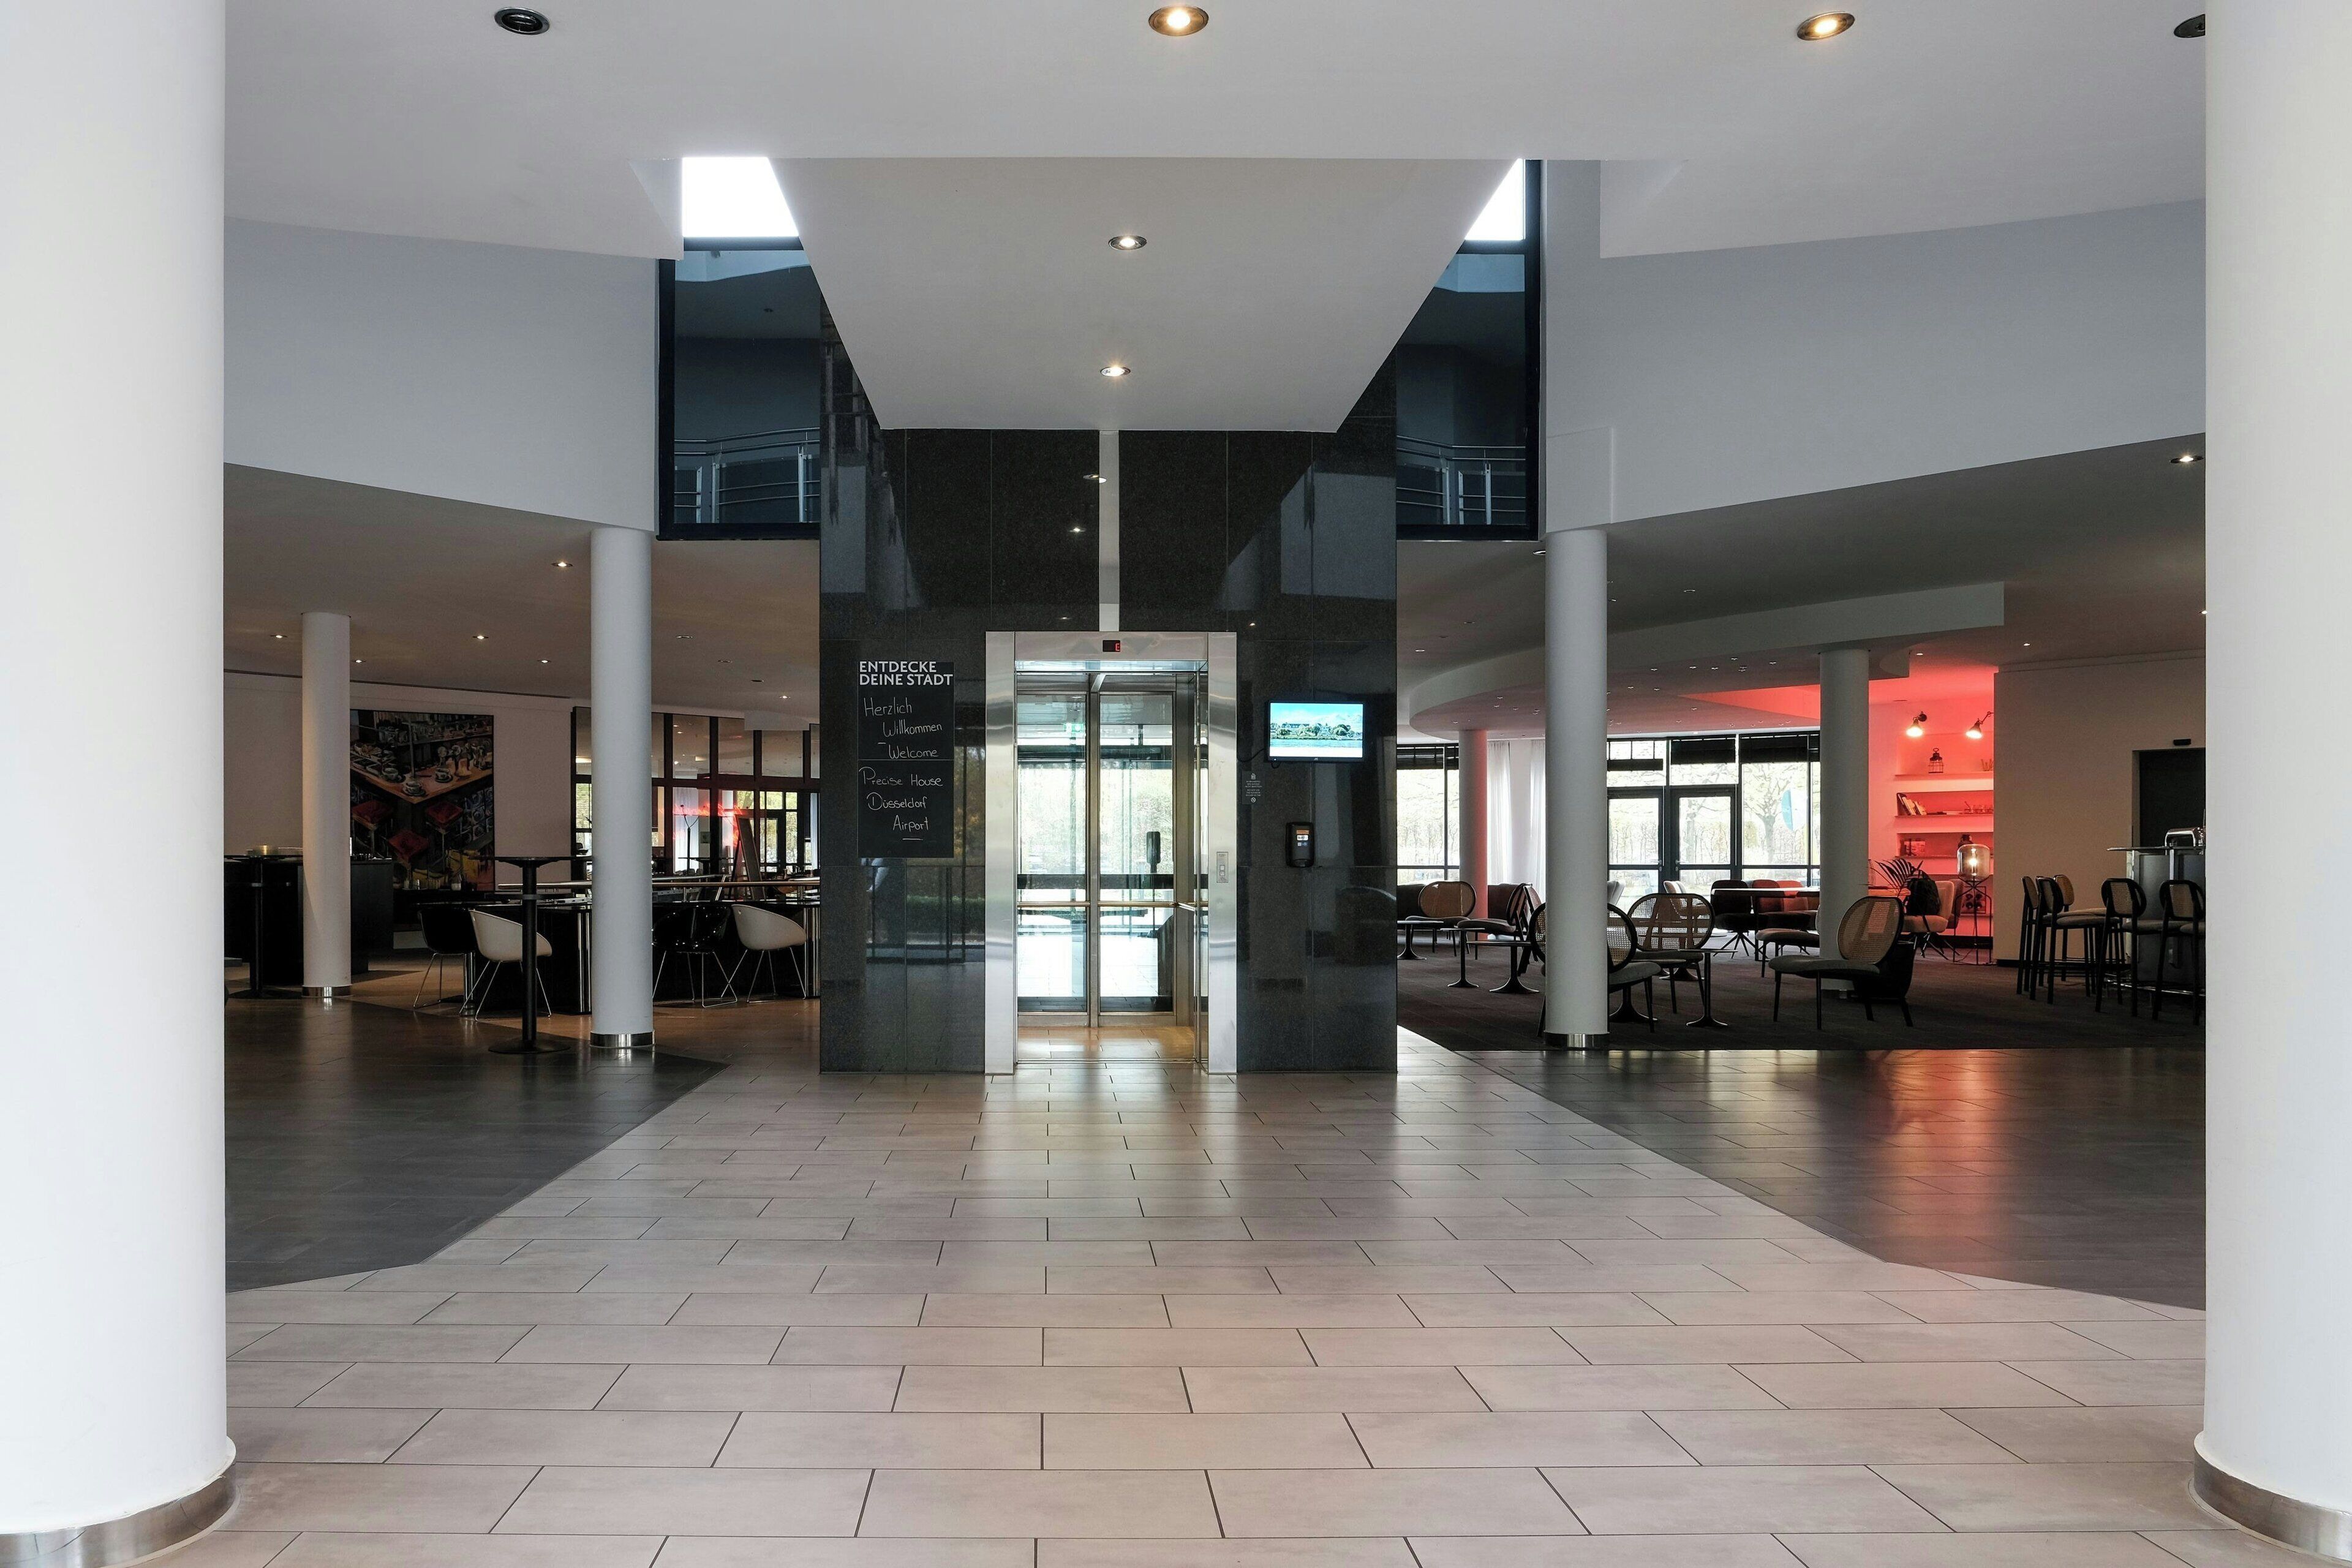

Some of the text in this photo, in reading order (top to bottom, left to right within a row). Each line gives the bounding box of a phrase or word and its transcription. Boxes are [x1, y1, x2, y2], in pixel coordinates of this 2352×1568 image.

[859, 661, 937, 673] ENTDECKE
[859, 674, 954, 685] DEINE STADT
[864, 696, 912, 717] Herzlich
[883, 718, 943, 737] Willkommen
[889, 744, 940, 759] Welcome
[859, 766, 943, 786] Precise House
[867, 792, 927, 810] Düsseldorf
[893, 815, 929, 832] Airport
